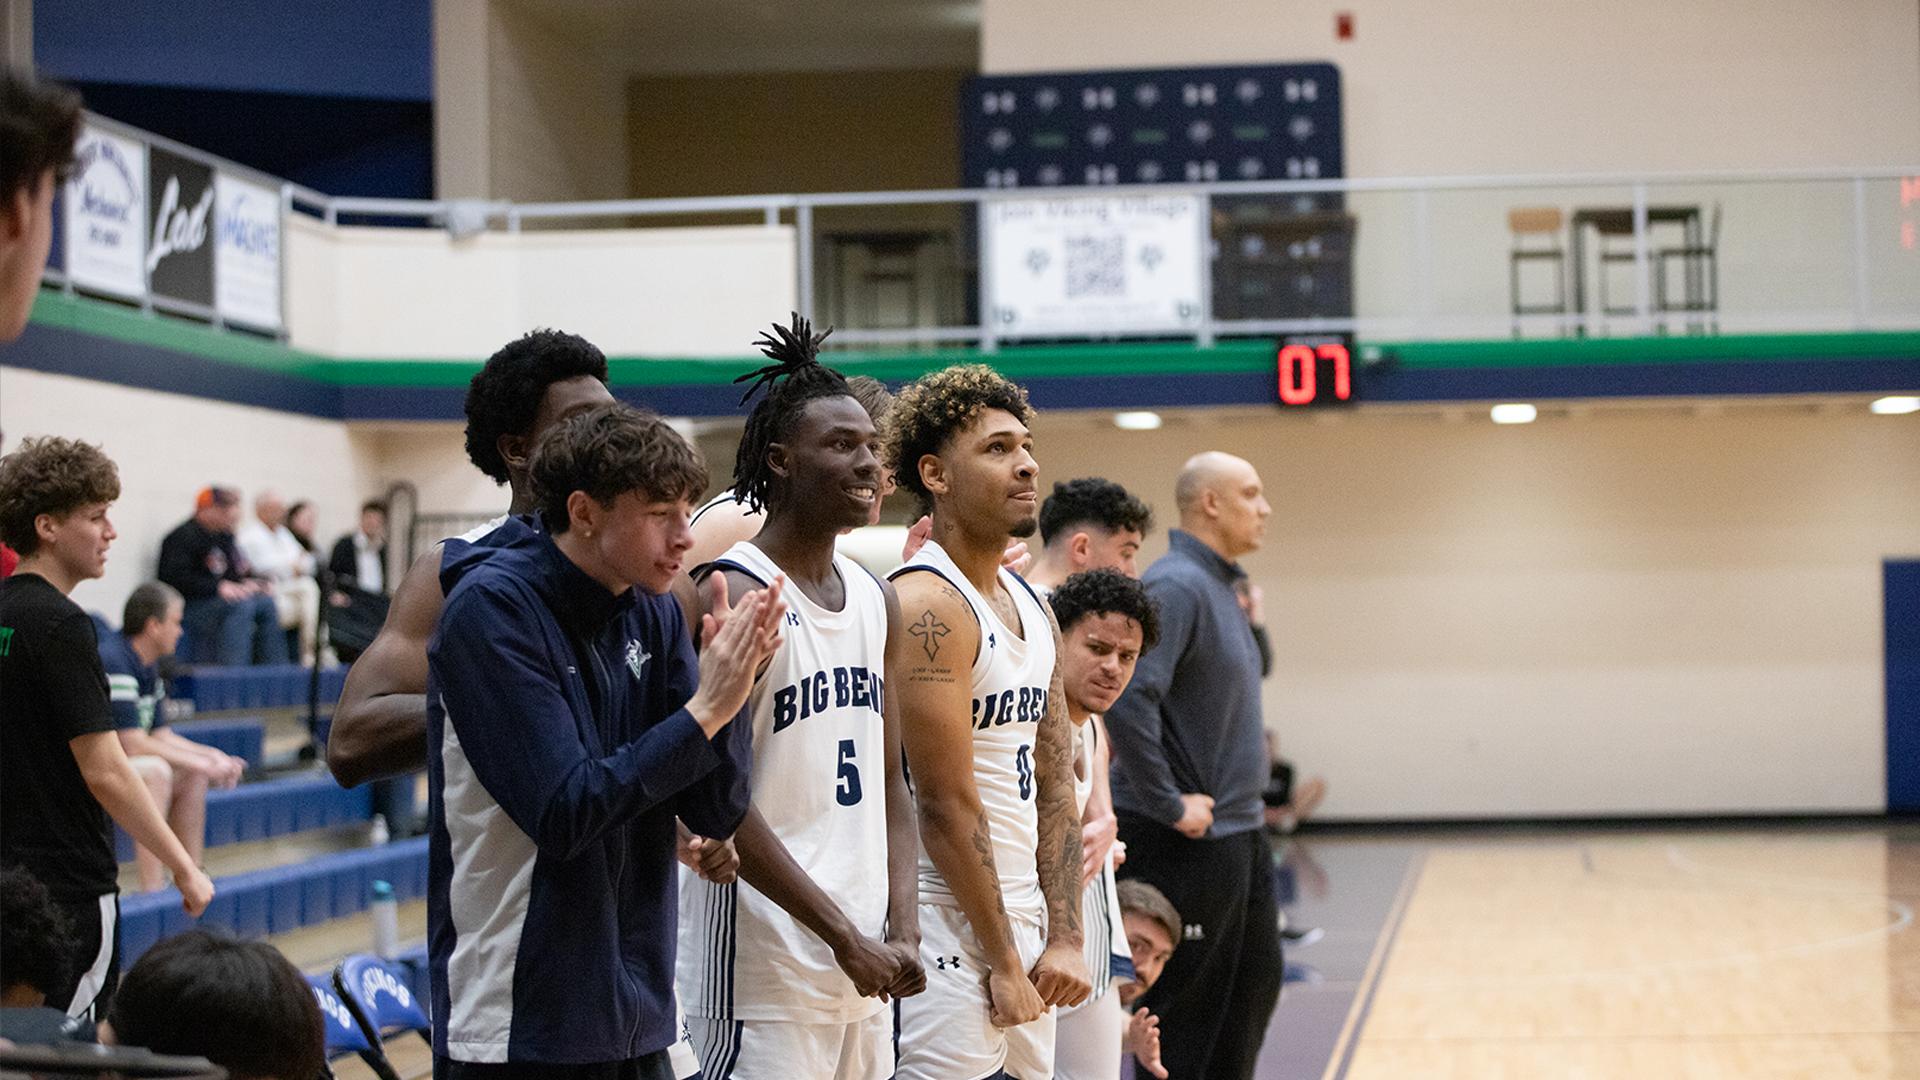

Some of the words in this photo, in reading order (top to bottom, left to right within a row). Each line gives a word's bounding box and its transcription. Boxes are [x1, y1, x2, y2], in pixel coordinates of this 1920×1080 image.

[1278, 344, 1351, 405] 07
[773, 670, 829, 734] BIG
[836, 739, 863, 807] 5
[1016, 744, 1032, 801] 0
